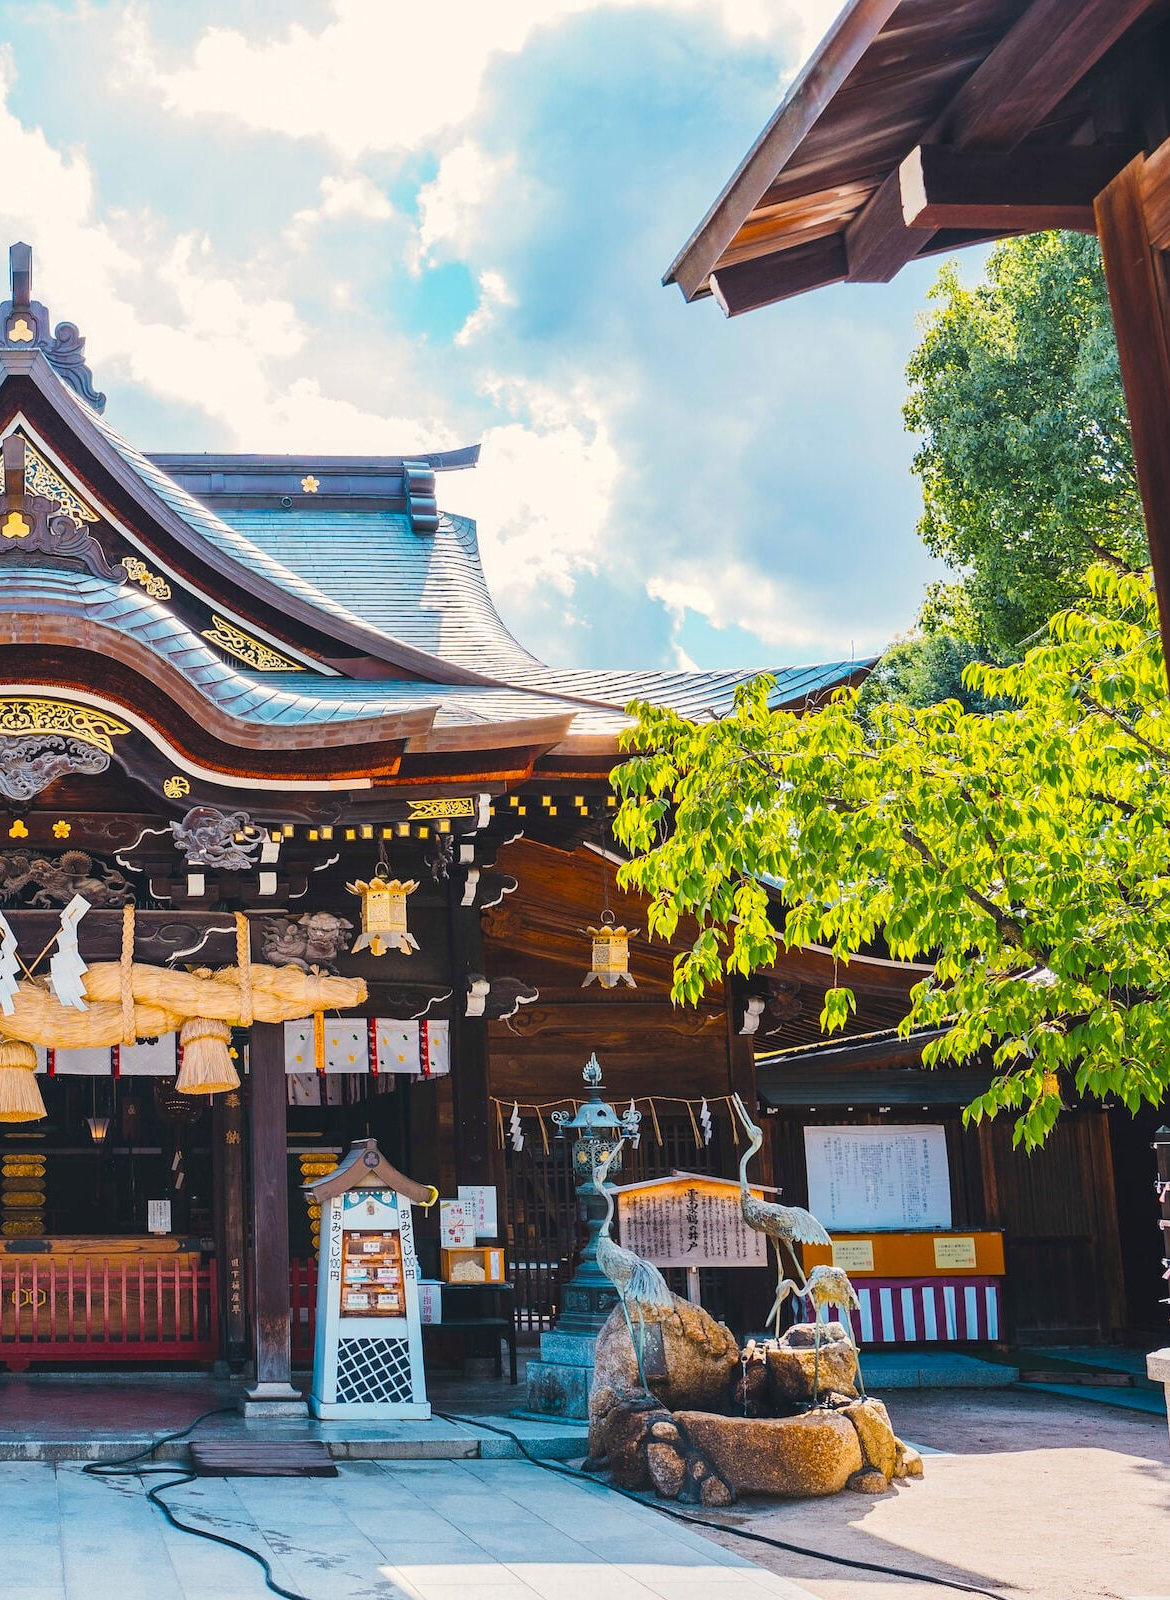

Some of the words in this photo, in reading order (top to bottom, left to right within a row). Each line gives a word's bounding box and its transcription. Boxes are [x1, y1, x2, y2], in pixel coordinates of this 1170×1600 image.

[330, 1211, 342, 1281] おみくじ100円
[400, 1209, 415, 1280] おみくじ100円
